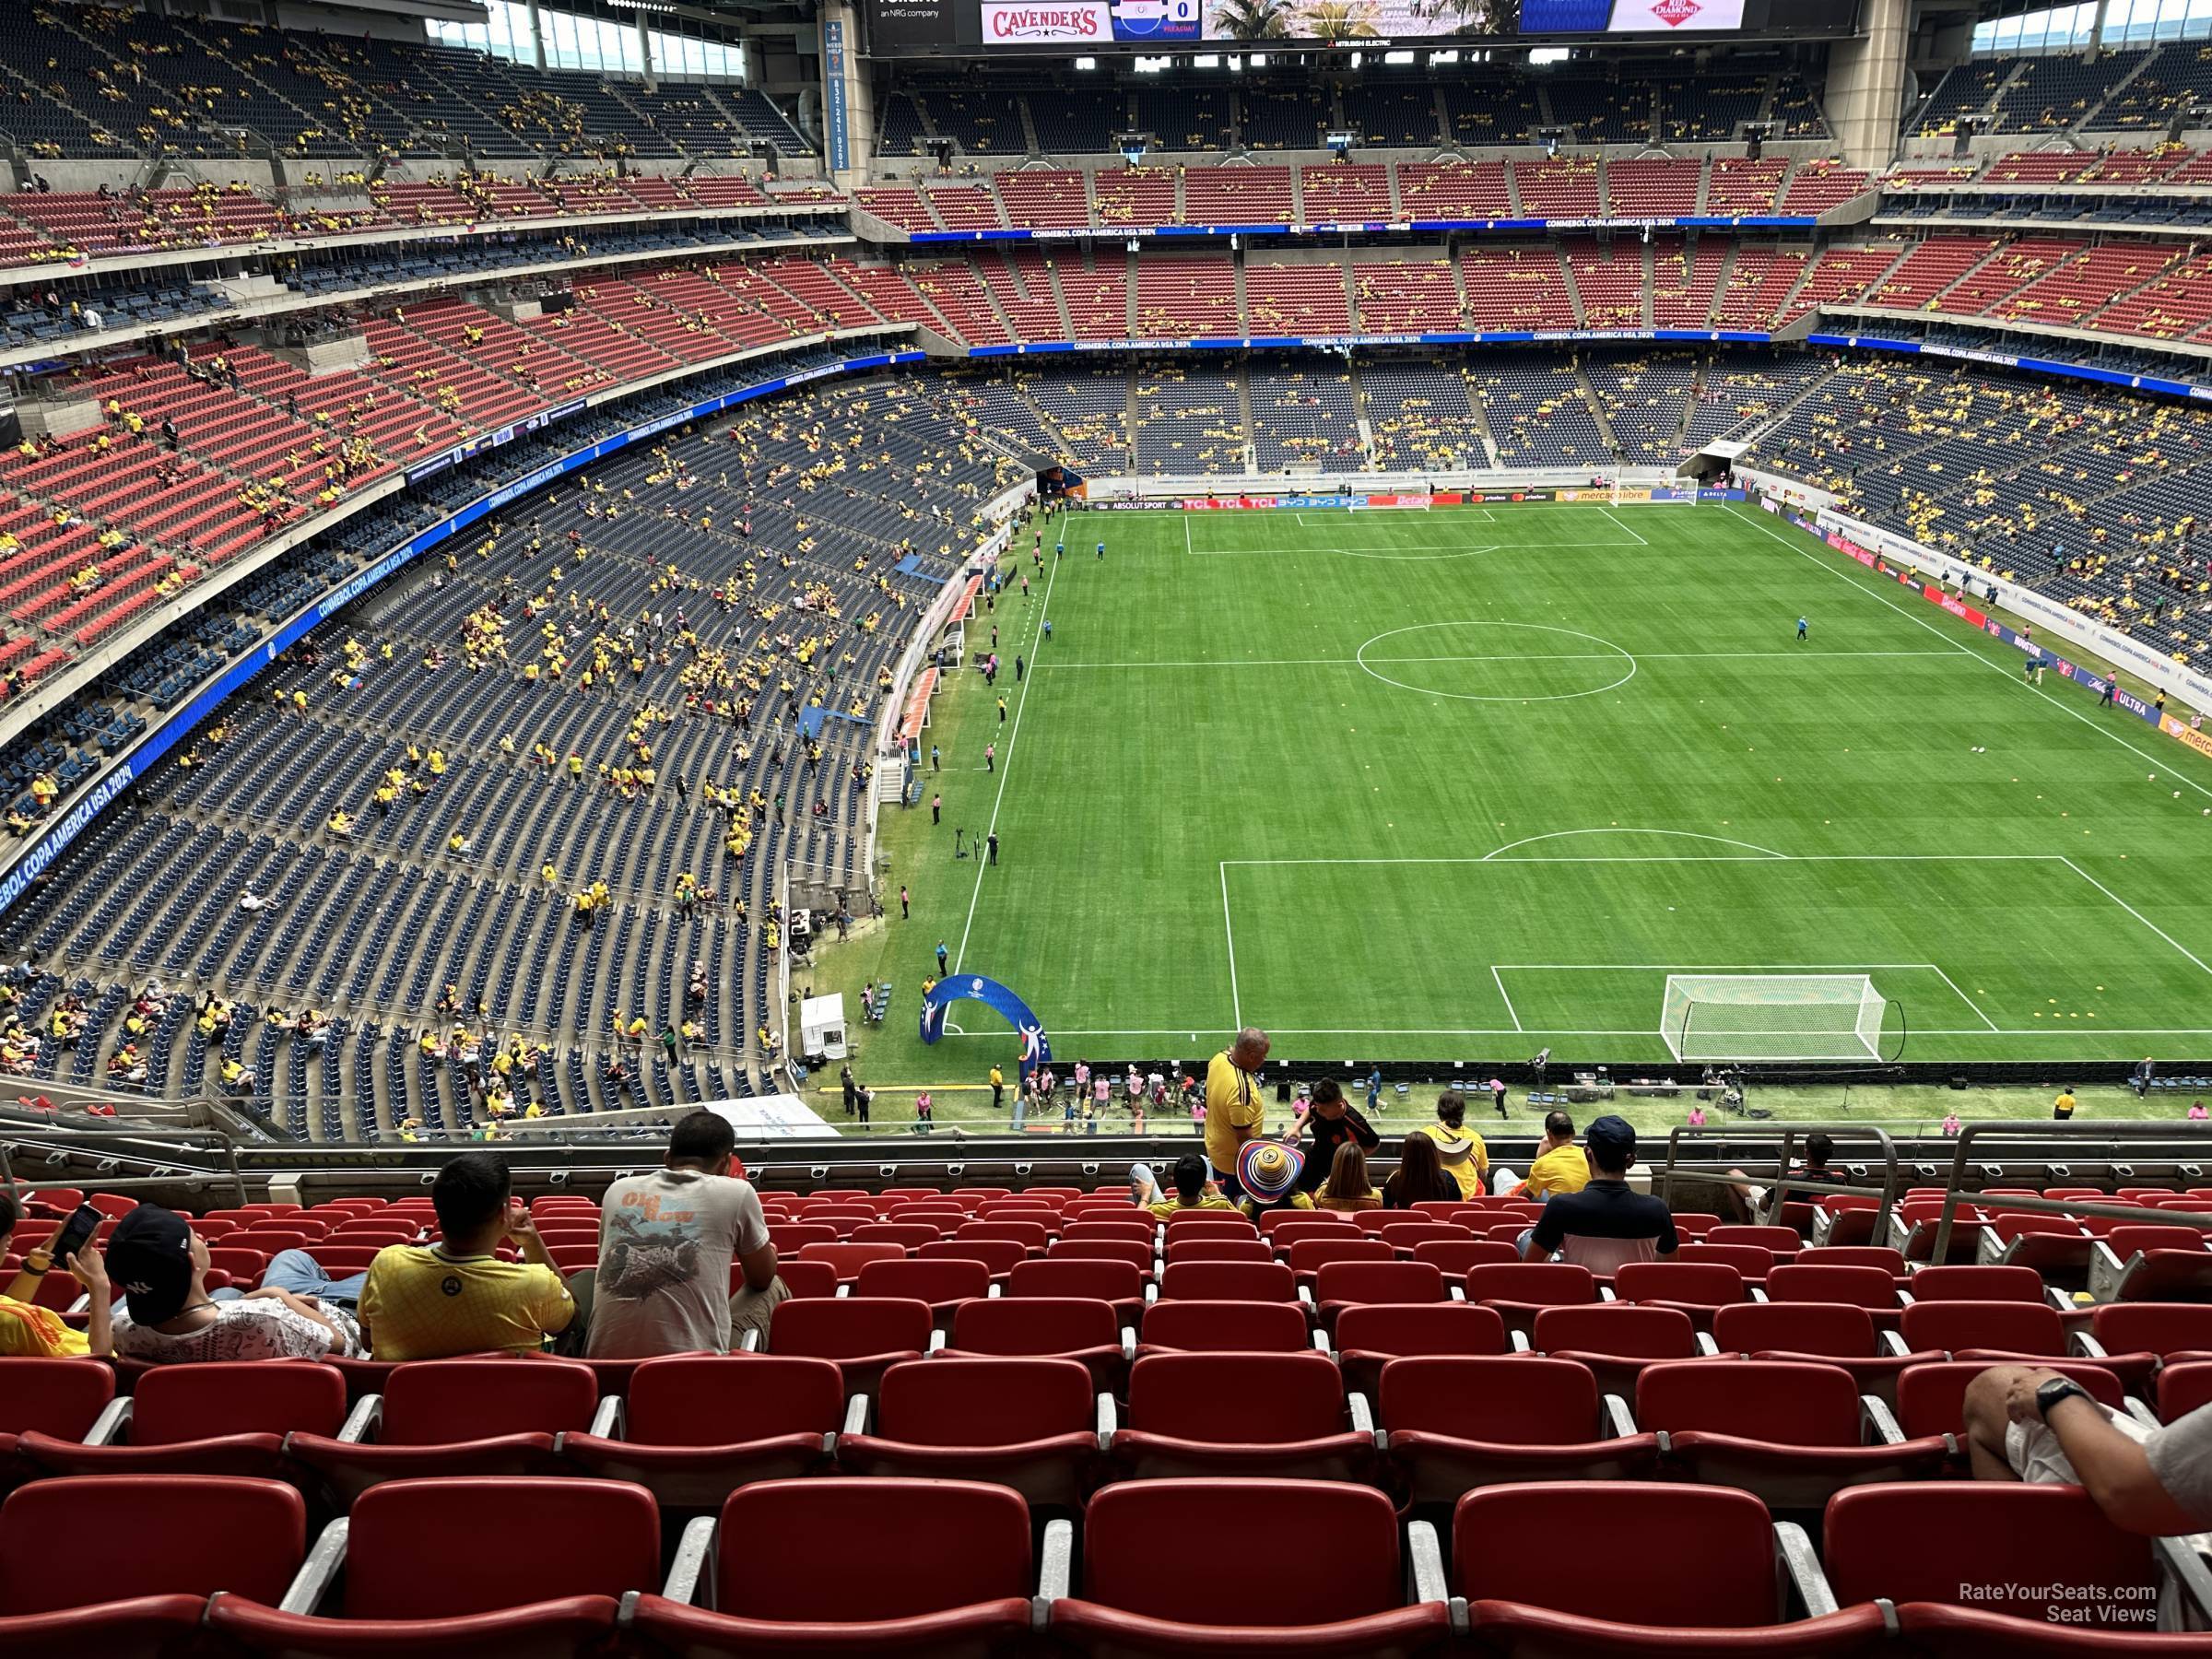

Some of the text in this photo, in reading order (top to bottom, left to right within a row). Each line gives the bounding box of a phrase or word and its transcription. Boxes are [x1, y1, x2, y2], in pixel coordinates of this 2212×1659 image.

[889, 9, 906, 18] NRG
[907, 10, 939, 18] company
[1178, 2, 1188, 18] 0
[1655, 6, 1698, 14] DIAMOND
[993, 7, 1098, 37] CAVENDER'S
[1546, 219, 1586, 228] CONMEBOL
[1606, 218, 1641, 227] AMERICA
[1359, 336, 1390, 345] AMERICA
[1623, 490, 1643, 499] libre
[1112, 501, 1143, 510] ABSOLUT
[1184, 499, 1210, 509] TCL
[1218, 499, 1243, 509] TCL
[1250, 498, 1277, 508] TCL
[319, 546, 414, 618] CONMEBOL COPA AMERICA USA 2024
[2014, 634, 2041, 658] HOUSTON
[2119, 692, 2146, 716] ULTRA
[23, 841, 54, 880] COPA
[52, 800, 94, 854] AMERICA
[90, 785, 112, 811] USA
[108, 764, 134, 798] 2024
